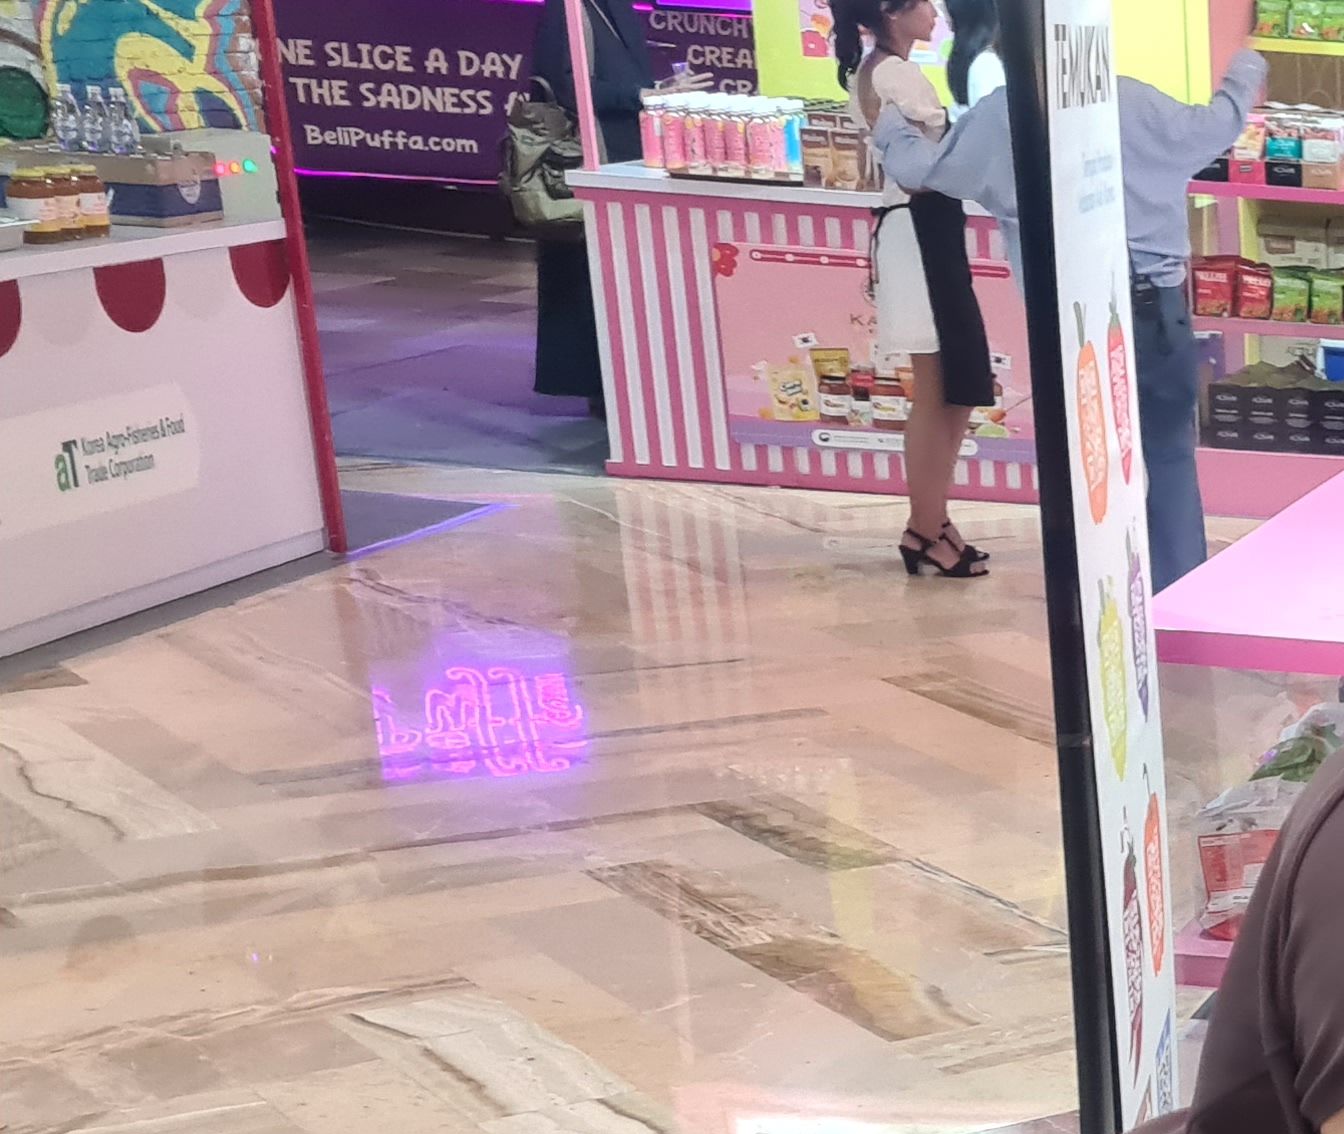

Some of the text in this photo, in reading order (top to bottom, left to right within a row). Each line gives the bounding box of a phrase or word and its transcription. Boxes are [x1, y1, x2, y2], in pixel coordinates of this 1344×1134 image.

[276, 38, 523, 80] NE SLICE A DAY
[289, 77, 352, 106] THE
[359, 82, 494, 115] SADNESS
[304, 124, 479, 154] BeliPuffa.com
